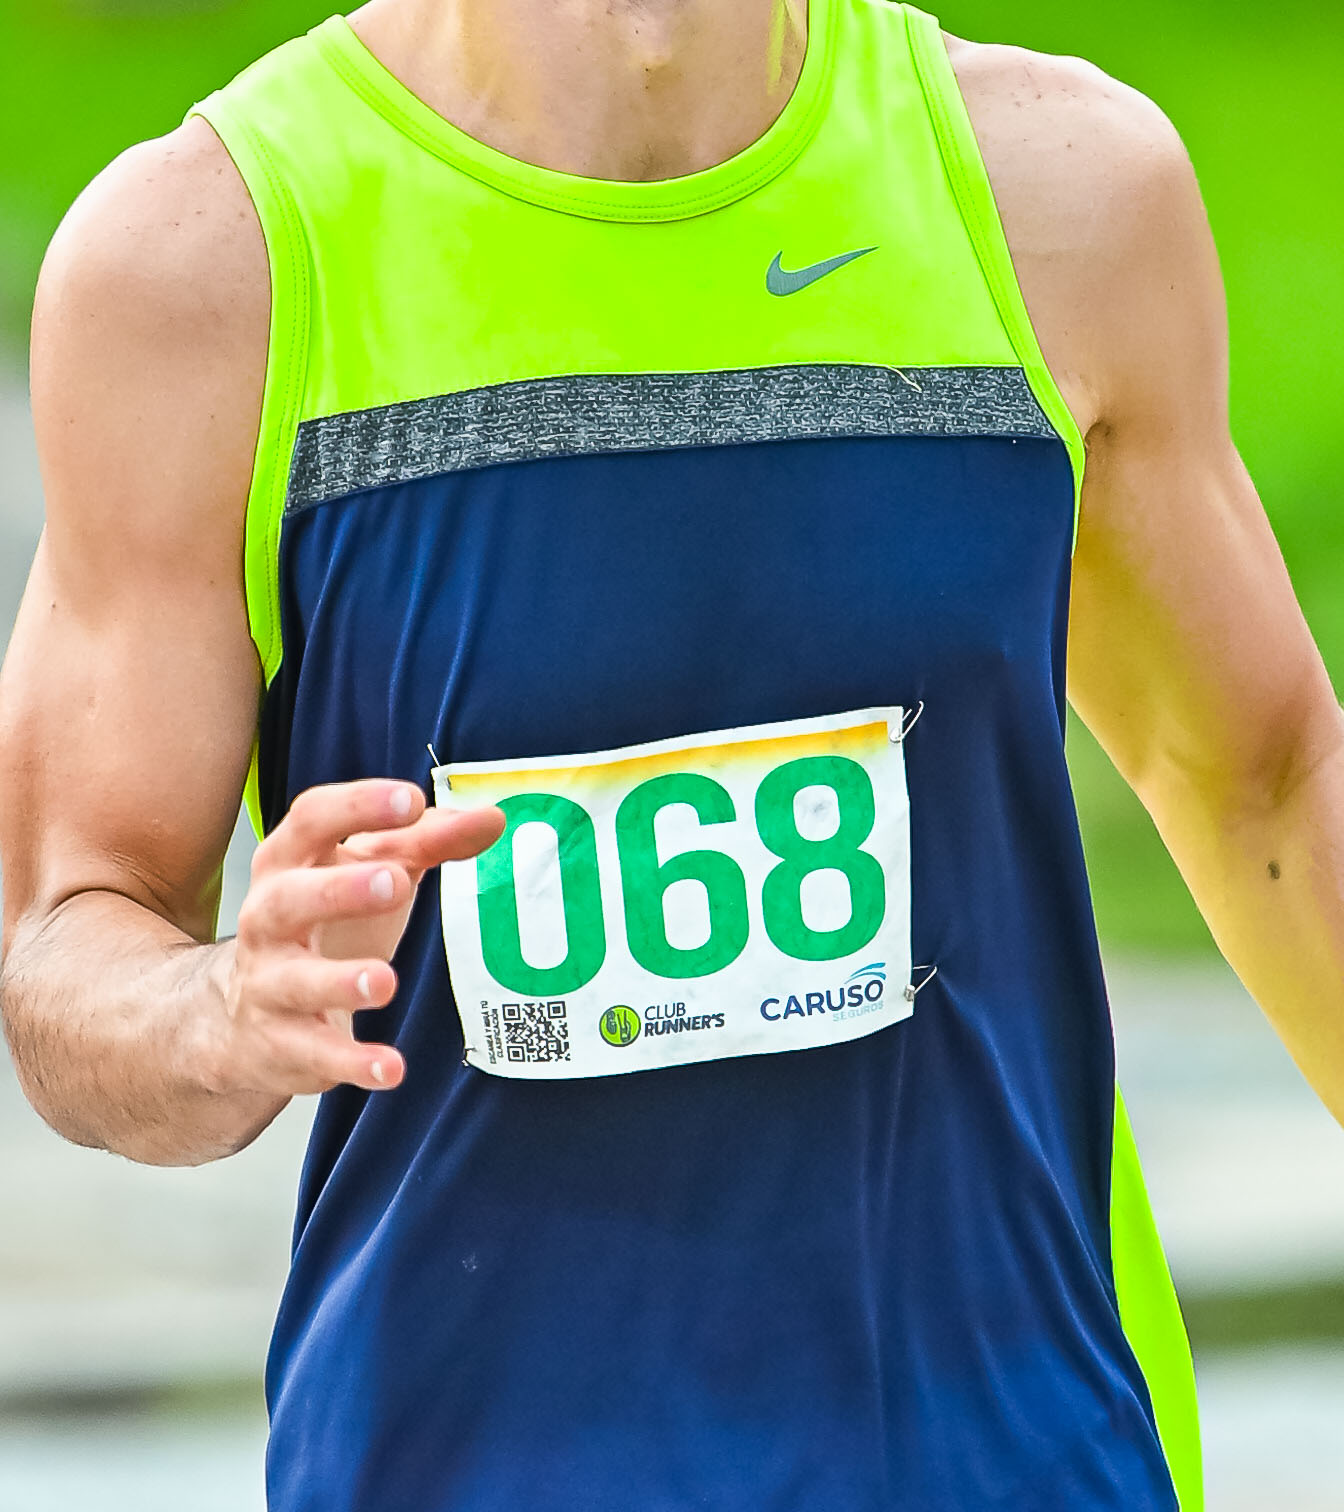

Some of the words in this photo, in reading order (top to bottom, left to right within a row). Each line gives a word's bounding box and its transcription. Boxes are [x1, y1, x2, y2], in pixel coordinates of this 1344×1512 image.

[476, 755, 886, 997] 068
[643, 1002, 686, 1021] CLUB
[760, 979, 884, 1021] CARUSO
[832, 1000, 884, 1022] SEGUROS
[644, 1012, 725, 1037] RUNNER'S
